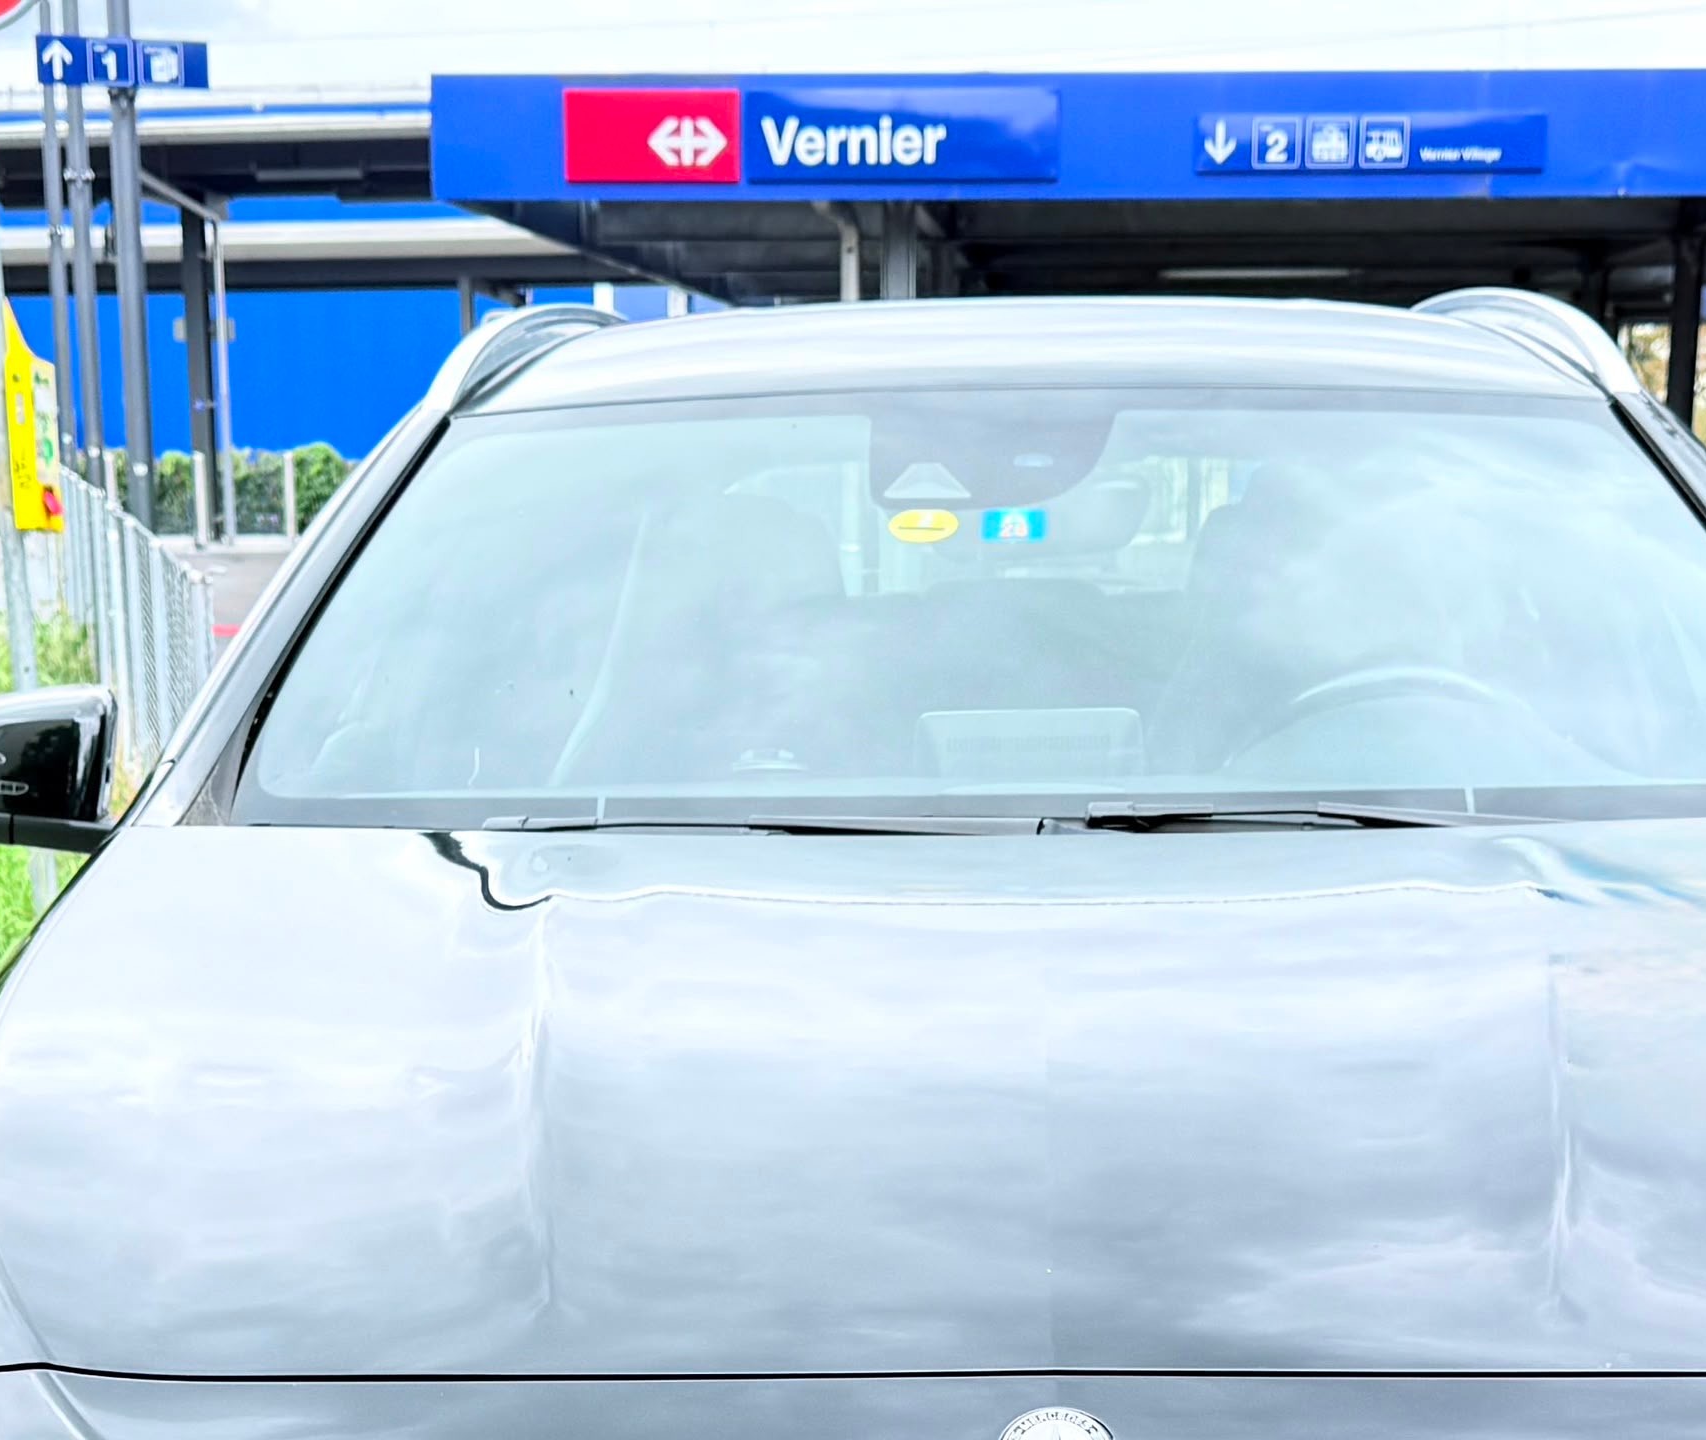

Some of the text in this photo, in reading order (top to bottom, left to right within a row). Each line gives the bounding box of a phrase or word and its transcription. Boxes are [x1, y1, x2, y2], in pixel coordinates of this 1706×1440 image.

[100, 49, 118, 82] 1
[760, 114, 947, 167] Vernier
[1264, 129, 1289, 163] 2
